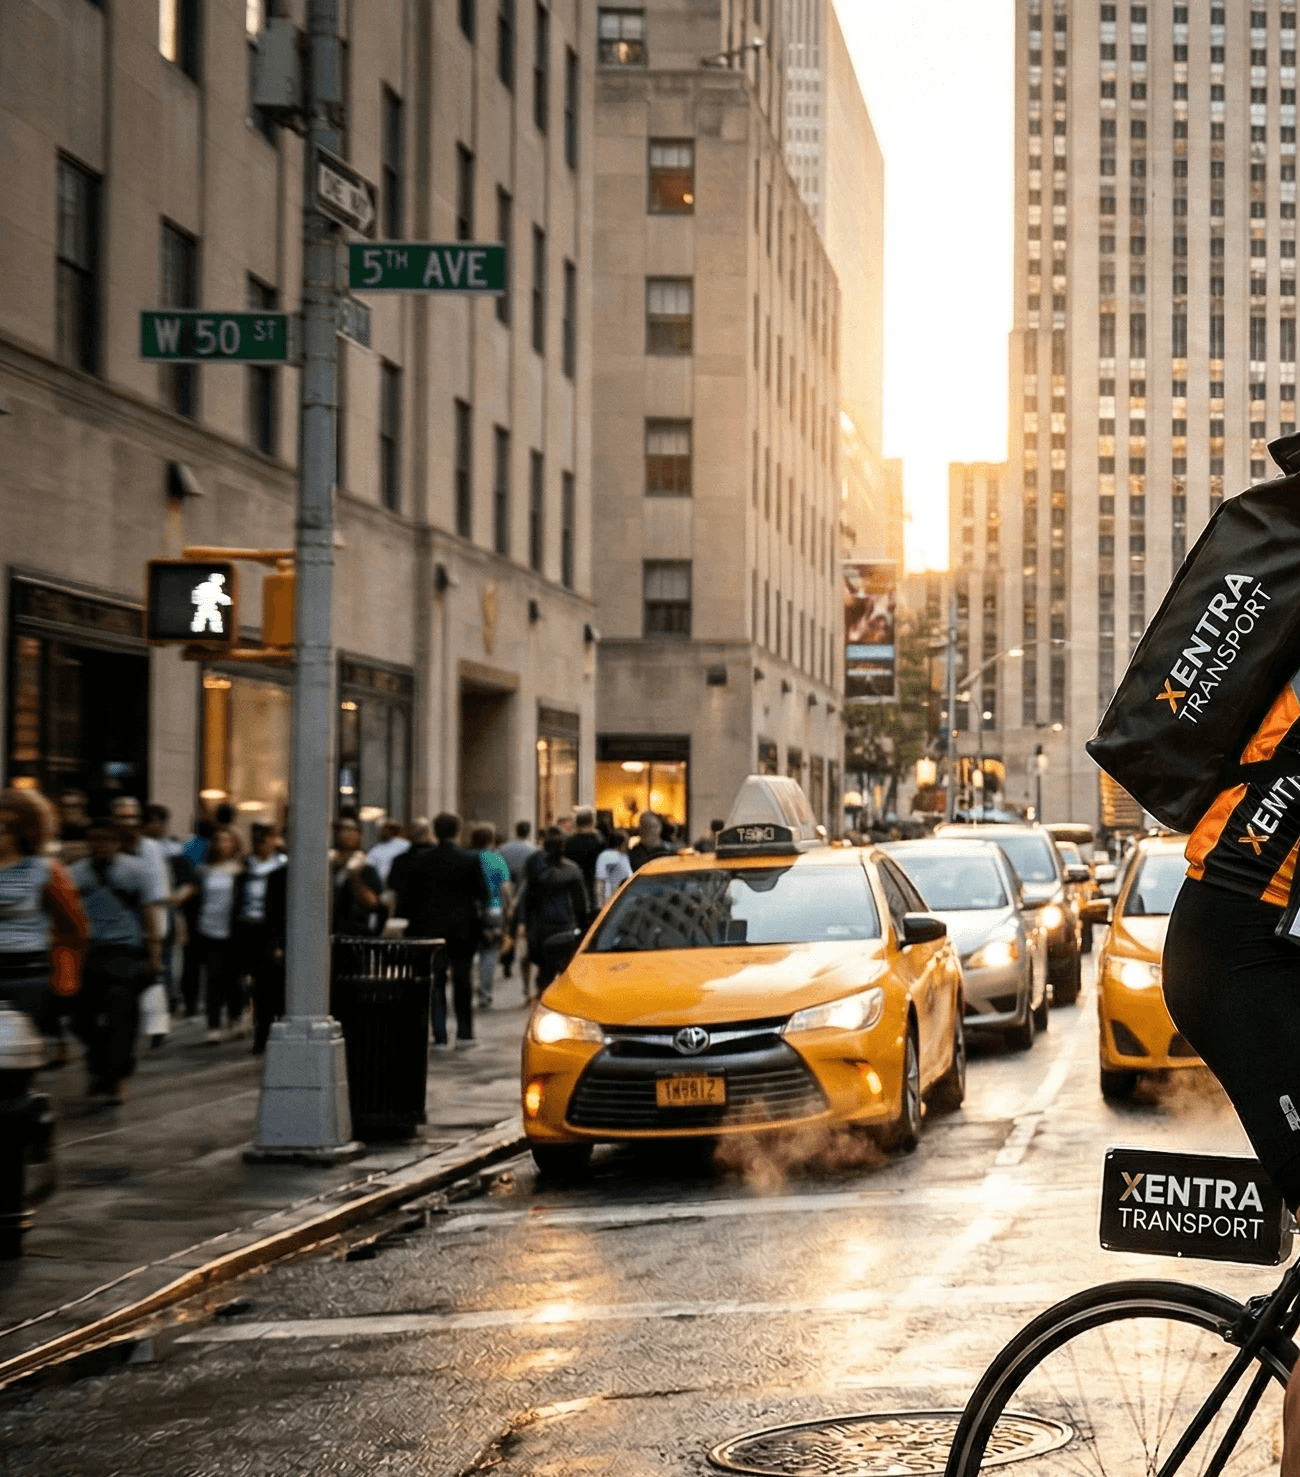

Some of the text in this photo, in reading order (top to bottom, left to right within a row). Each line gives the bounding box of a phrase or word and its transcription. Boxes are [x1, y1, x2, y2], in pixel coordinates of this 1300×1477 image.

[362, 250, 488, 287] 5TH AVE
[154, 317, 277, 354] W 50 ST
[1156, 574, 1254, 714] XENTRA
[1178, 582, 1271, 723] TRANSPORT
[1119, 1171, 1264, 1212] XENTRA
[1118, 1207, 1264, 1240] TRANSPORT
